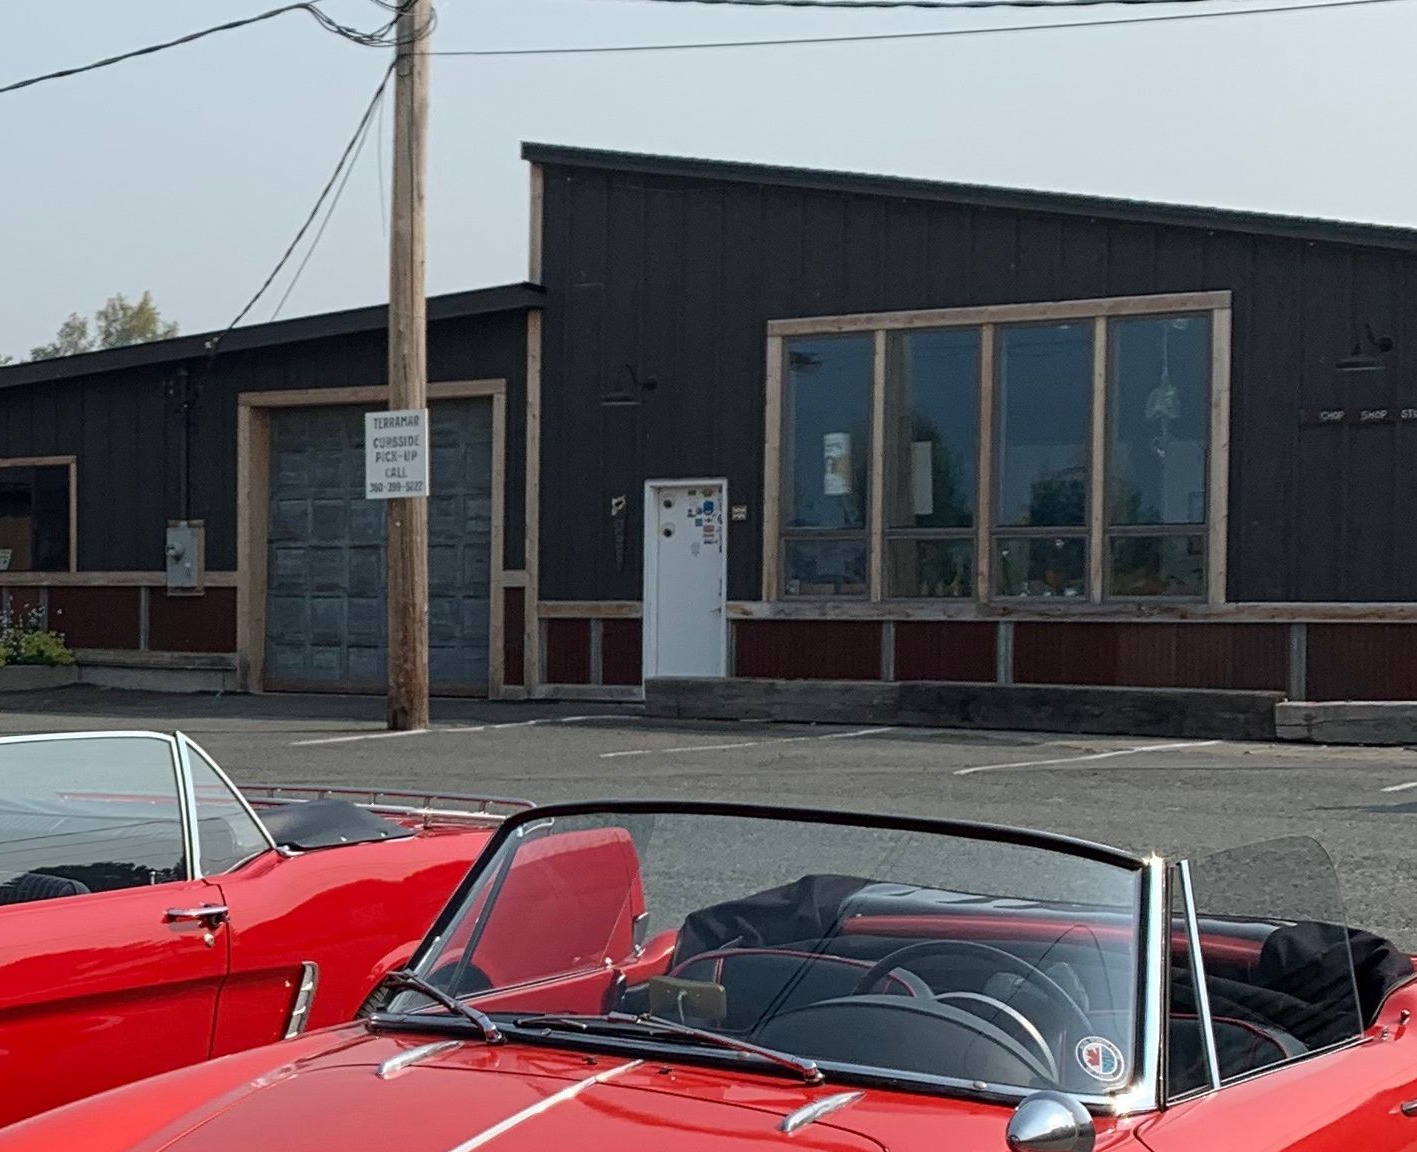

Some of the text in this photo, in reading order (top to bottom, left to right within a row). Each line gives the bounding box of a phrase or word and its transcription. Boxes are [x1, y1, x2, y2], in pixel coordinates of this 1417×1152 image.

[374, 414, 420, 429] TERRAMAR
[373, 434, 420, 449] CURBSIDE
[375, 450, 418, 463] PICK-UP
[385, 466, 408, 478] CALL
